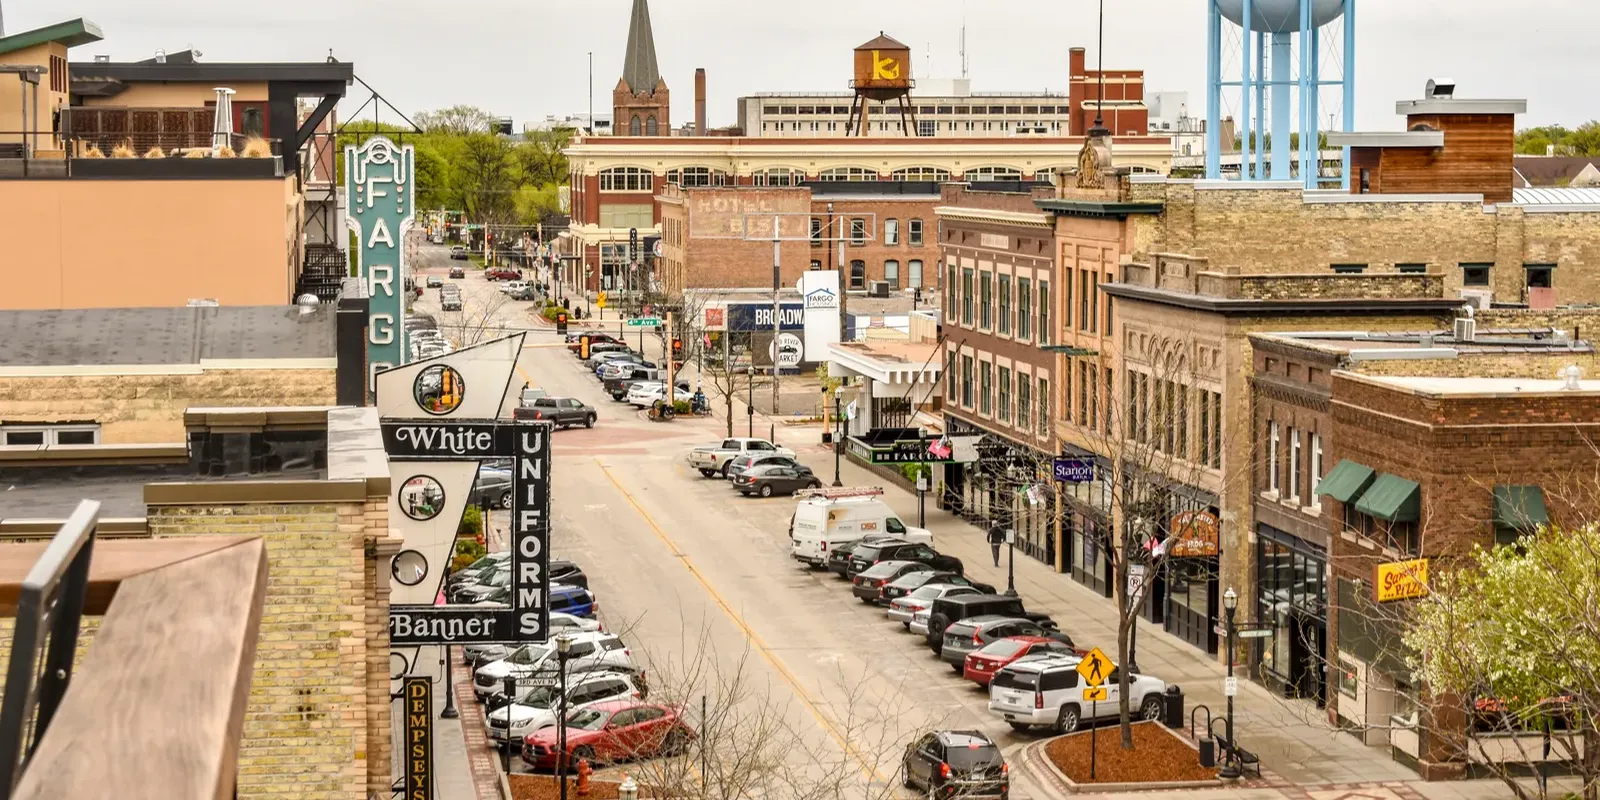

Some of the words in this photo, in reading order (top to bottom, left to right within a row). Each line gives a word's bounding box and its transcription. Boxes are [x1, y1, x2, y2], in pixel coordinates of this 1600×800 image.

[698, 198, 772, 213] HOTEL
[755, 309, 804, 325] BROADW
[779, 354, 798, 363] ARKET
[395, 426, 492, 455] White
[1056, 465, 1092, 476] Starion
[519, 432, 542, 635] UNIFORMS
[1187, 540, 1204, 548] FROG
[390, 614, 497, 640] Banner
[410, 685, 427, 800] DEMPSEYS
